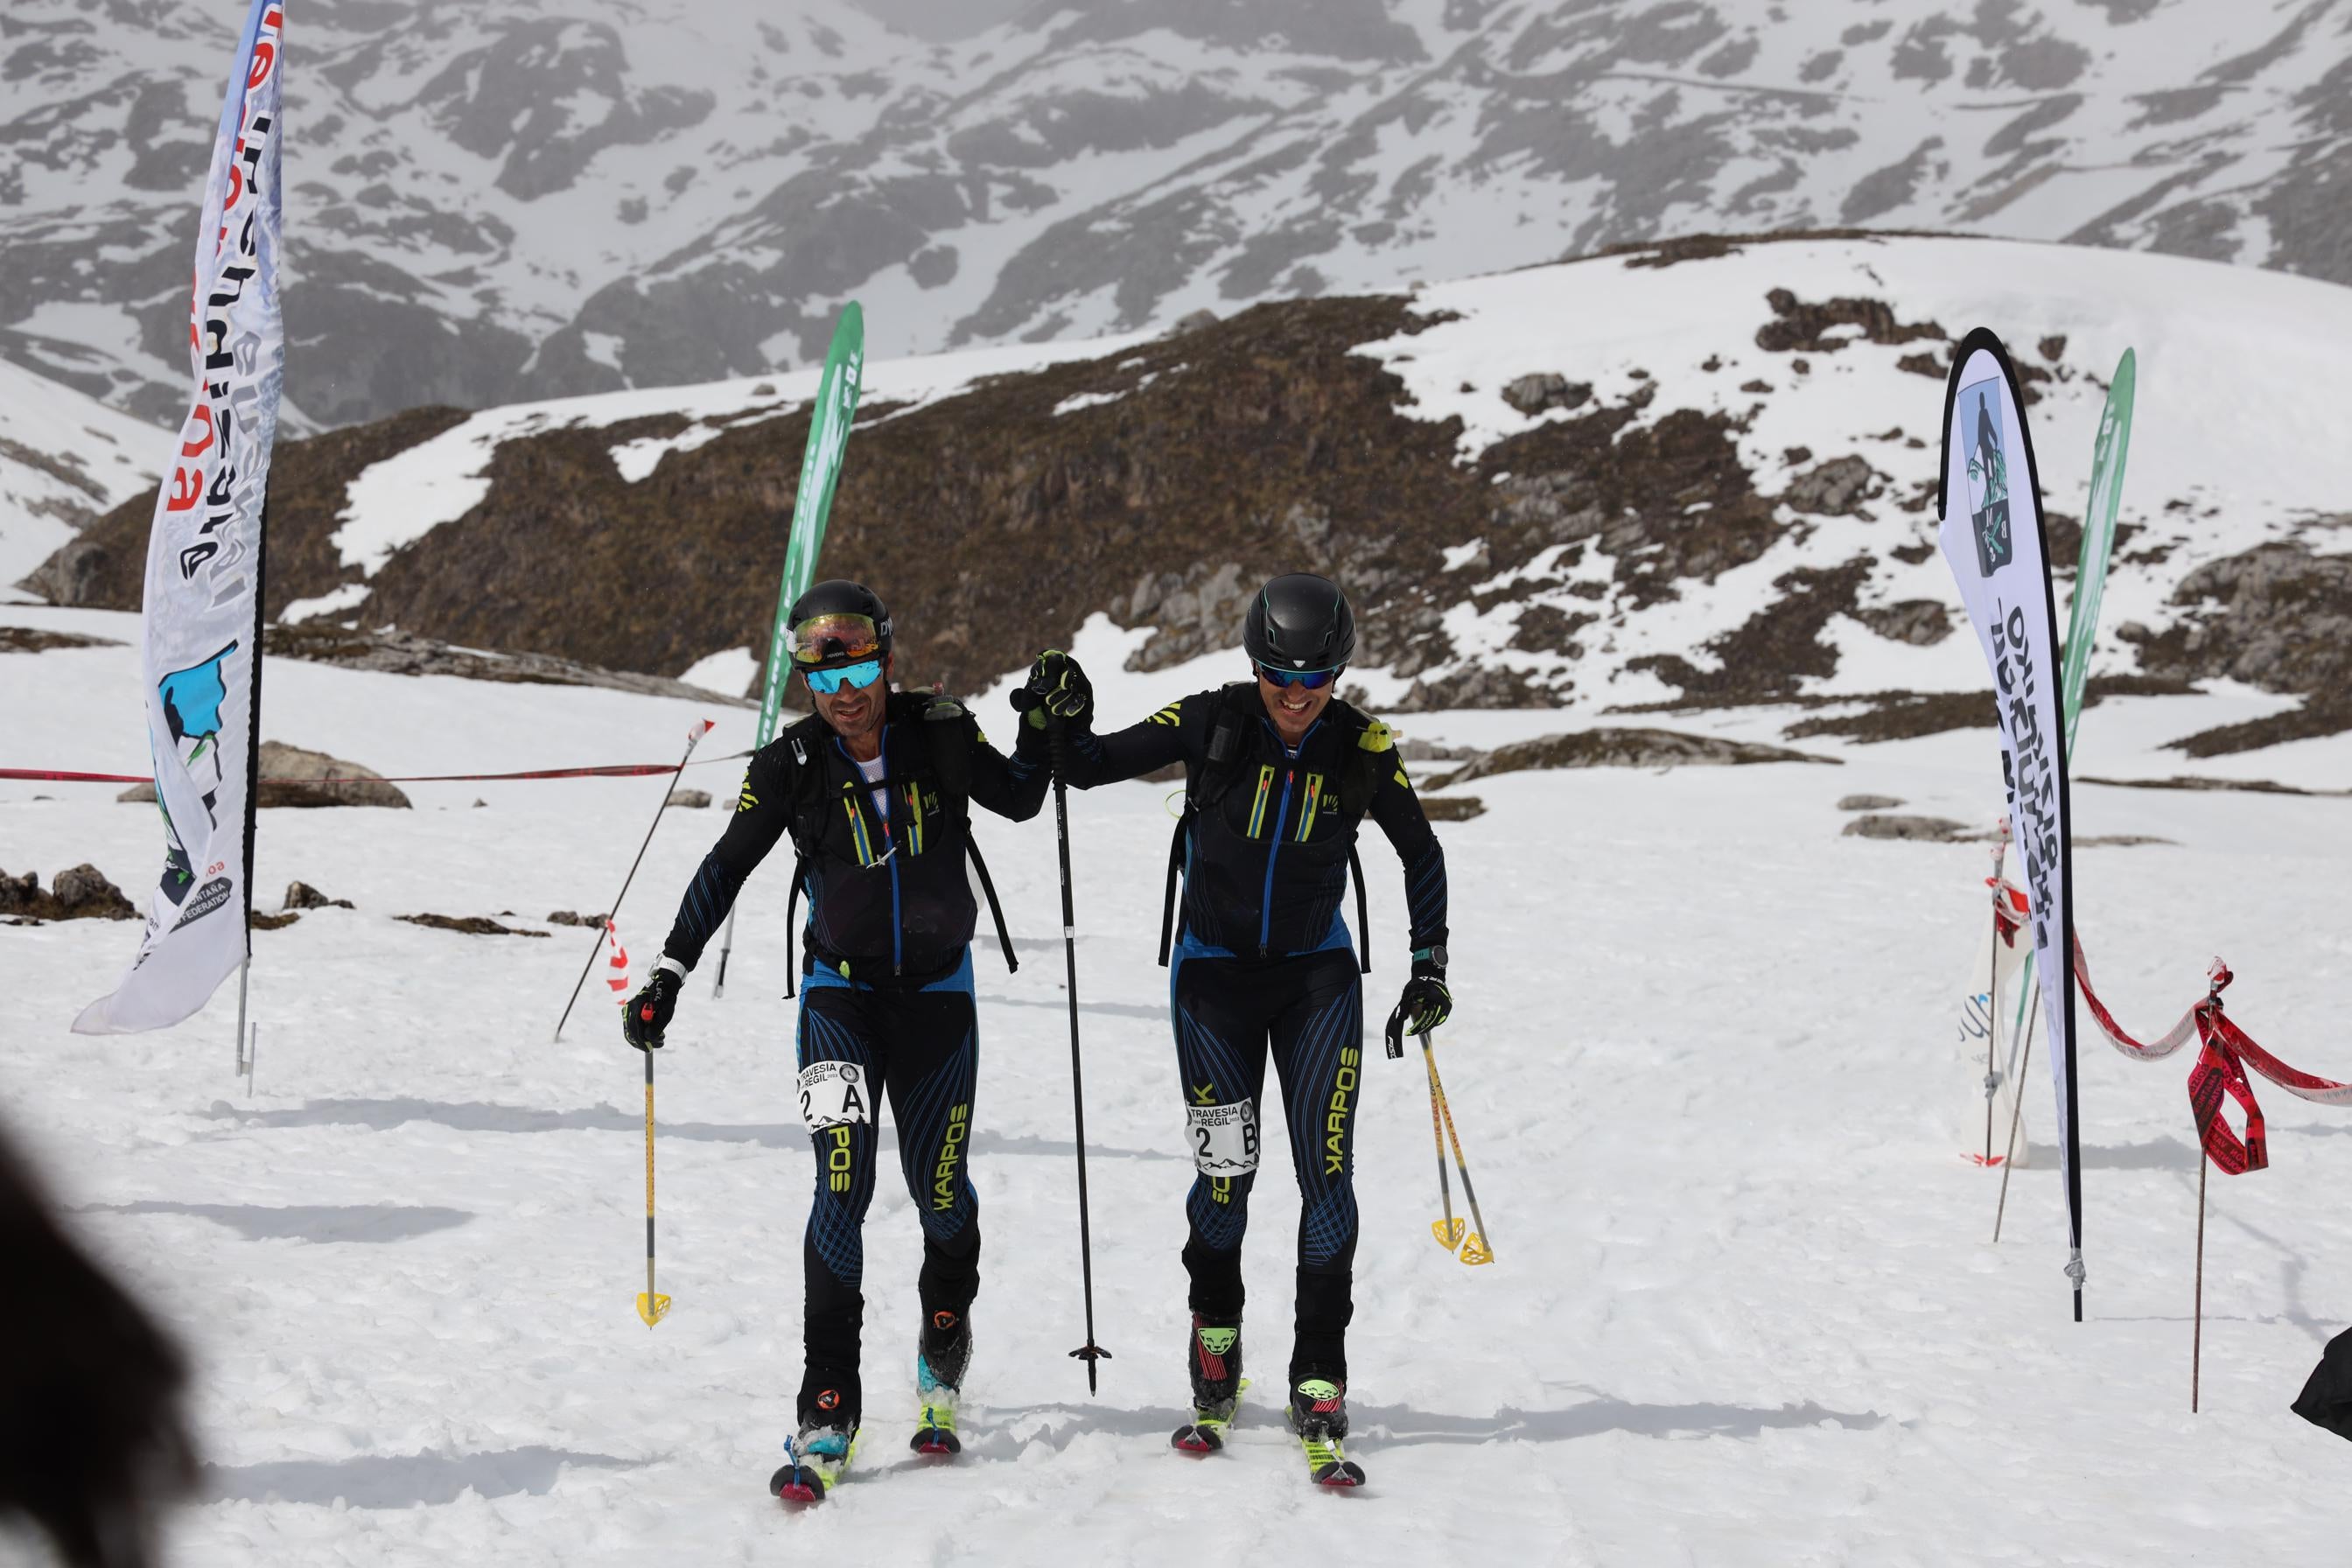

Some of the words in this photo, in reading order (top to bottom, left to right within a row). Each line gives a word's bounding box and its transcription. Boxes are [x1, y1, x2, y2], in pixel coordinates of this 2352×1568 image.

[181, 891, 229, 921] FEDERATION
[189, 883, 226, 906] ONTAÑA
[804, 1074, 828, 1088] REGIL
[801, 1090, 813, 1122] 2
[842, 1084, 864, 1113] A
[1326, 1046, 1359, 1175] KARPOS
[1201, 1117, 1230, 1127] REGIL
[1196, 1127, 1213, 1158] 2
[1242, 1123, 1258, 1156] B
[933, 1103, 968, 1211] KARPOS
